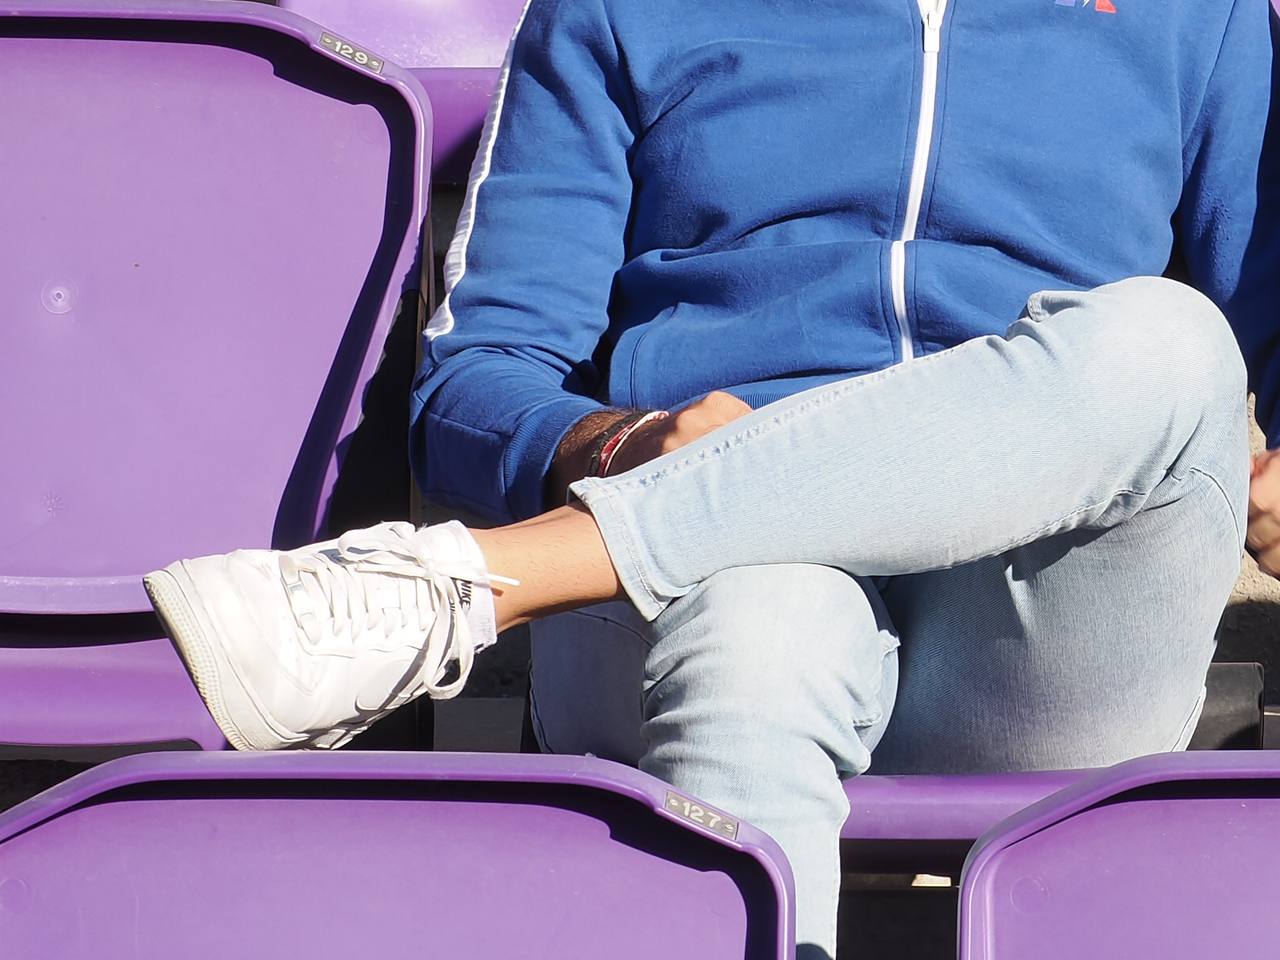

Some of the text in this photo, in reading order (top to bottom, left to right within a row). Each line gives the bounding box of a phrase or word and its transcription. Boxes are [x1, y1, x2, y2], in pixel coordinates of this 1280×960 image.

[335, 41, 368, 64] 129
[460, 581, 473, 610] NIKE
[683, 801, 720, 828] 127
